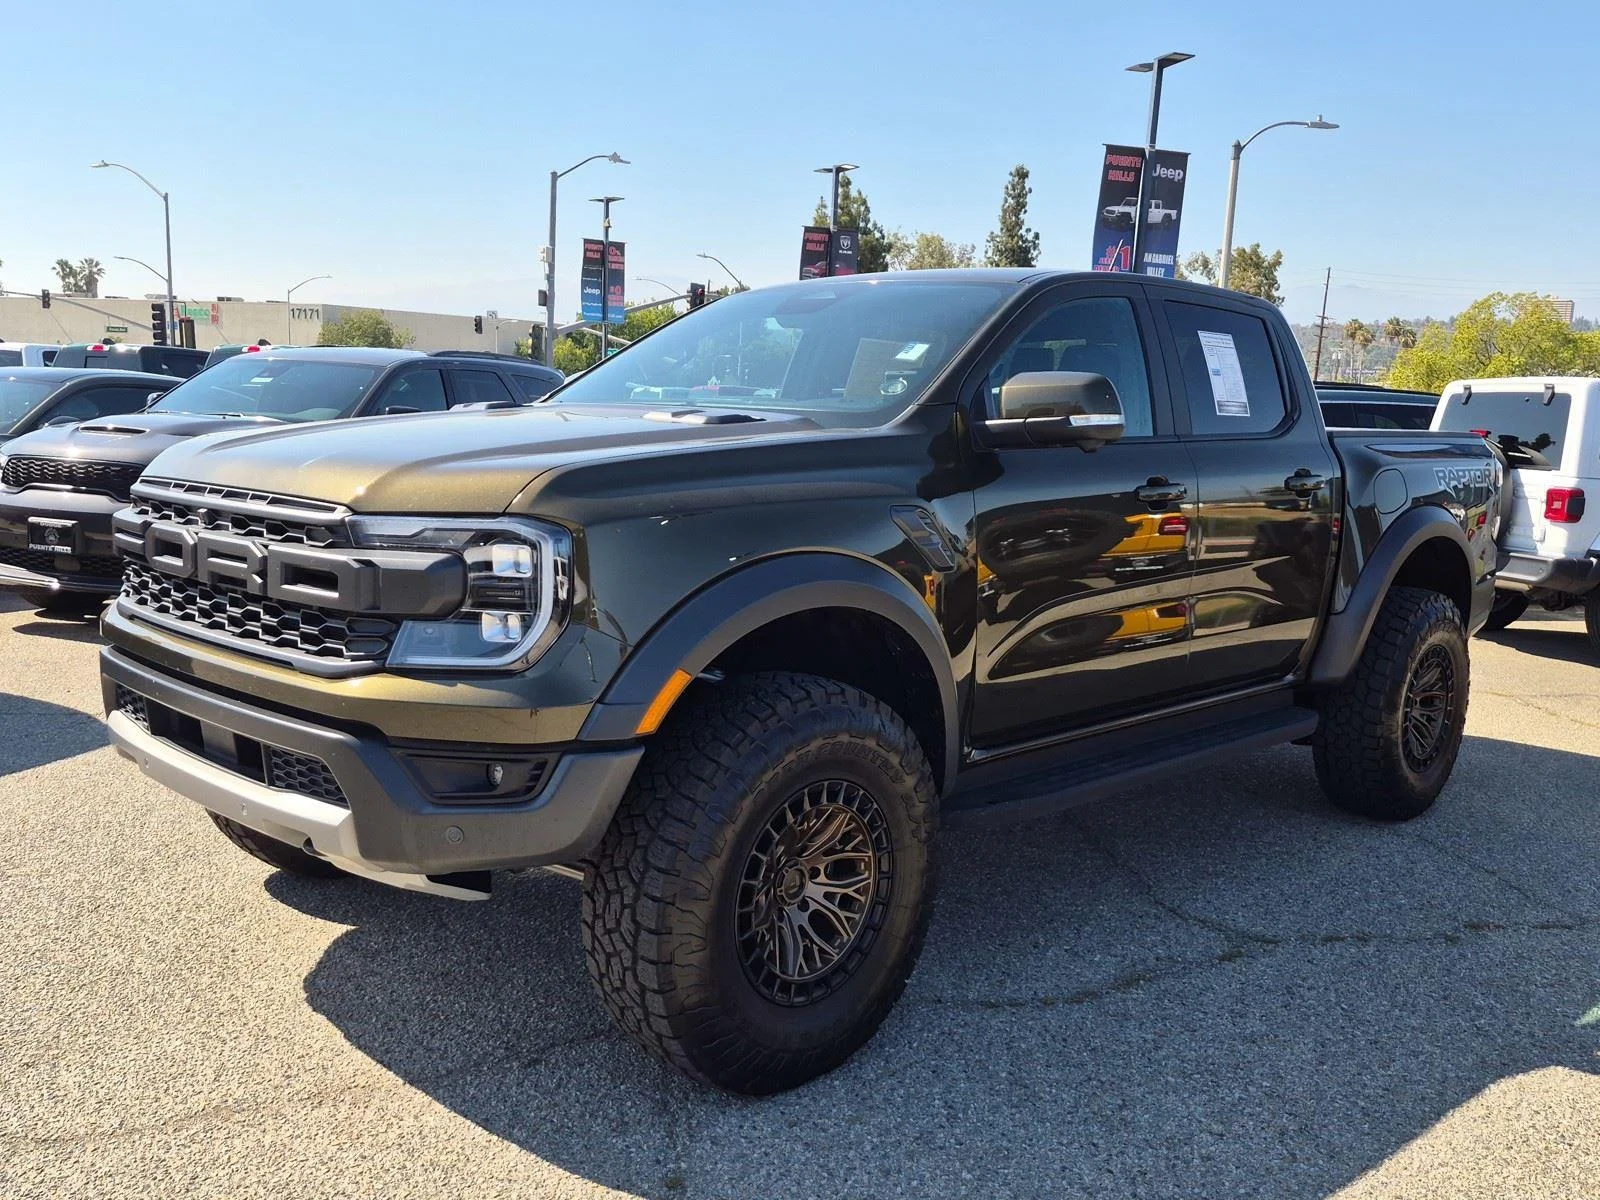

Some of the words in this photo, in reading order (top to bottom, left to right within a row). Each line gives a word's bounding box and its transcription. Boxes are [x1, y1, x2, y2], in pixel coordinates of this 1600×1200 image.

[1106, 154, 1142, 168] PUENTE
[1108, 170, 1135, 182] HILLS
[1152, 163, 1184, 182] Jeep
[584, 286, 601, 296] Jeep
[290, 307, 320, 320] 17171
[1433, 466, 1495, 499] RAPTOR
[29, 543, 53, 551] PUENTE
[112, 510, 377, 612] FORD
[815, 740, 906, 784] COUNTRY
